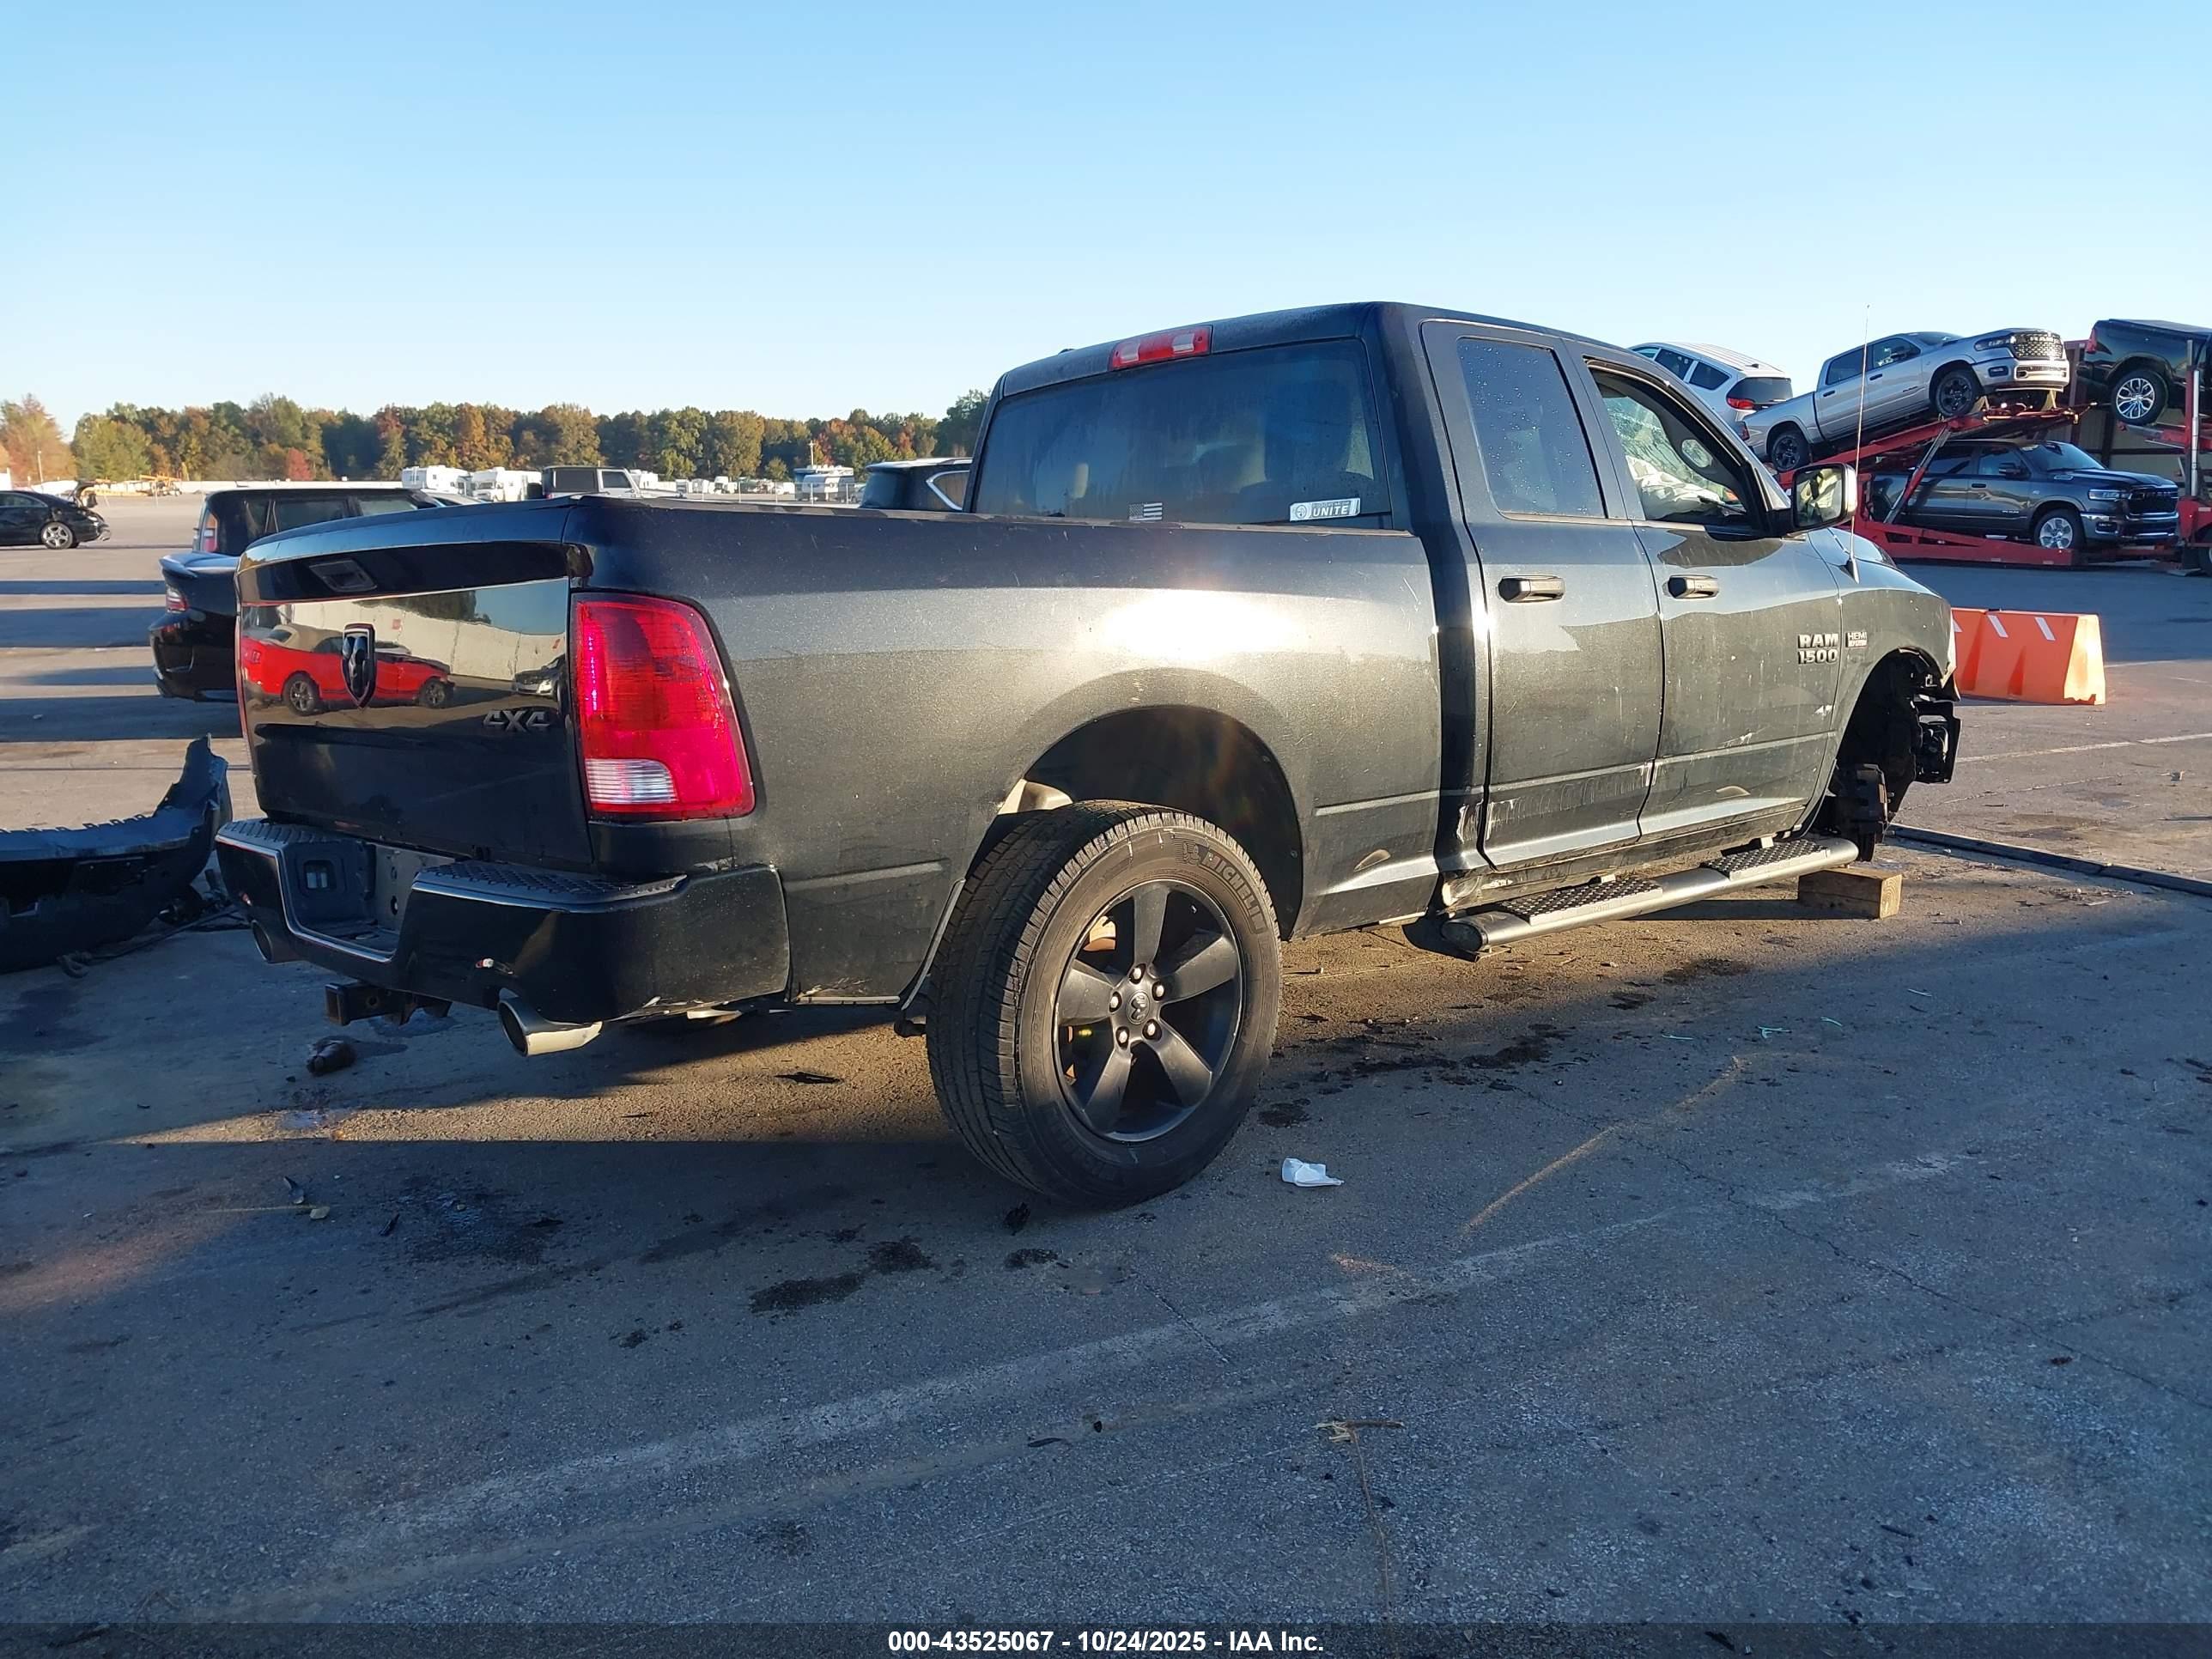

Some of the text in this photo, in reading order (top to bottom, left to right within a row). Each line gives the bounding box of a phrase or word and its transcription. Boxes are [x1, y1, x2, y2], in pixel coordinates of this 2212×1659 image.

[1312, 505, 1348, 517] UNITE
[1798, 633, 1839, 648] RAM
[1846, 631, 1868, 641] HEMI
[1798, 648, 1839, 665] 1500
[1201, 850, 1267, 931] MICHELIN
